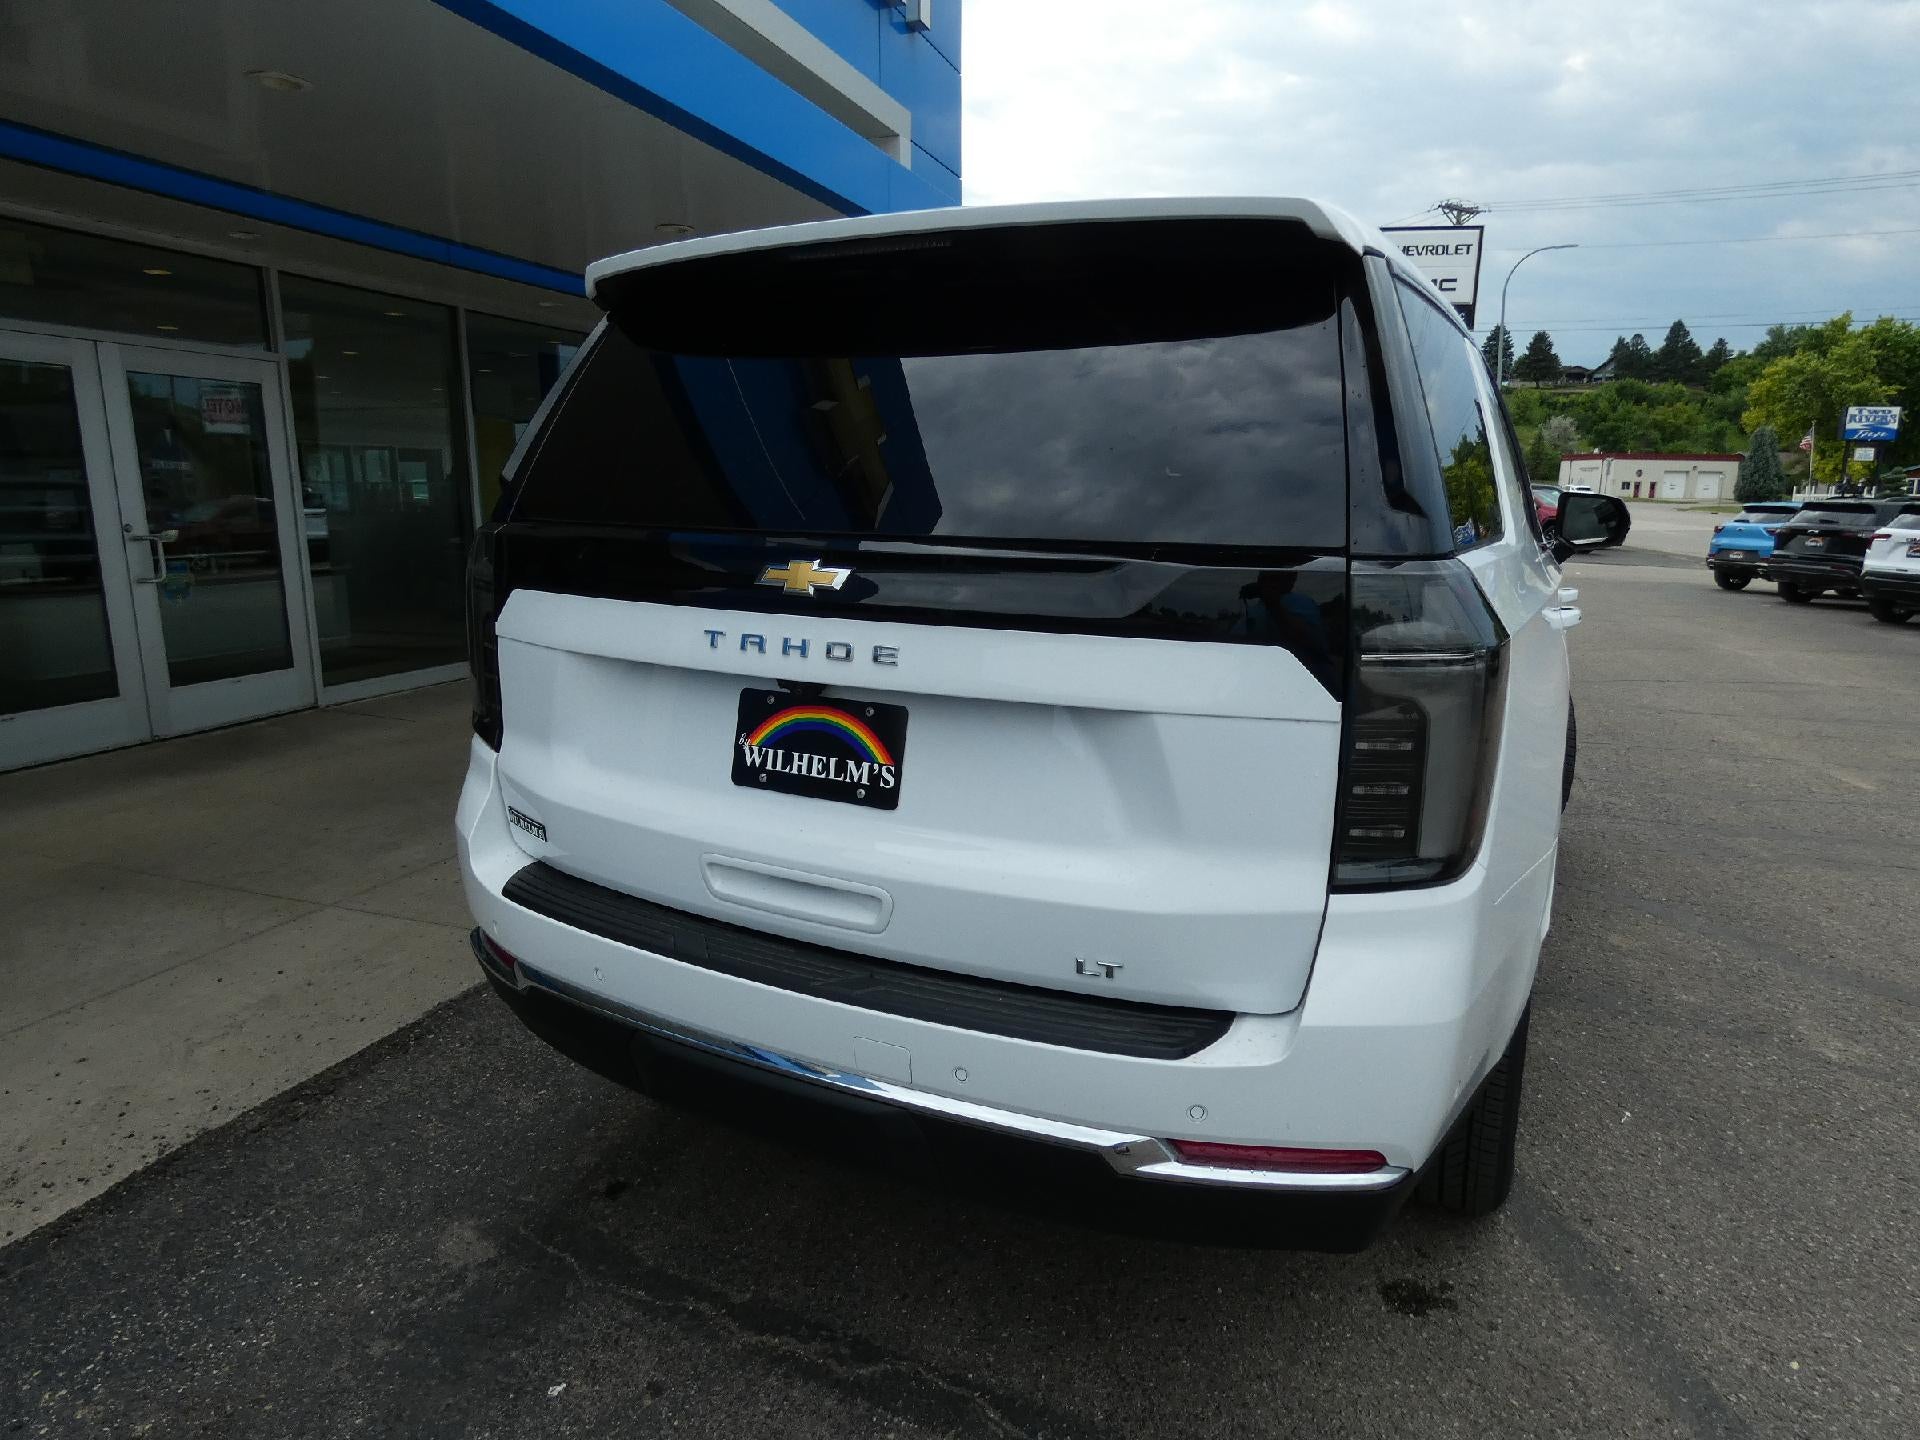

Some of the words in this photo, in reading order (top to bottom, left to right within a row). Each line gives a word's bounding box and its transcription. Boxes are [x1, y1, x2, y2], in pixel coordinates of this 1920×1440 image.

[1399, 243, 1474, 257] HEVROLET
[703, 629, 901, 667] TAHOE
[743, 744, 896, 789] WILHELM'S
[1075, 957, 1124, 980] LT
